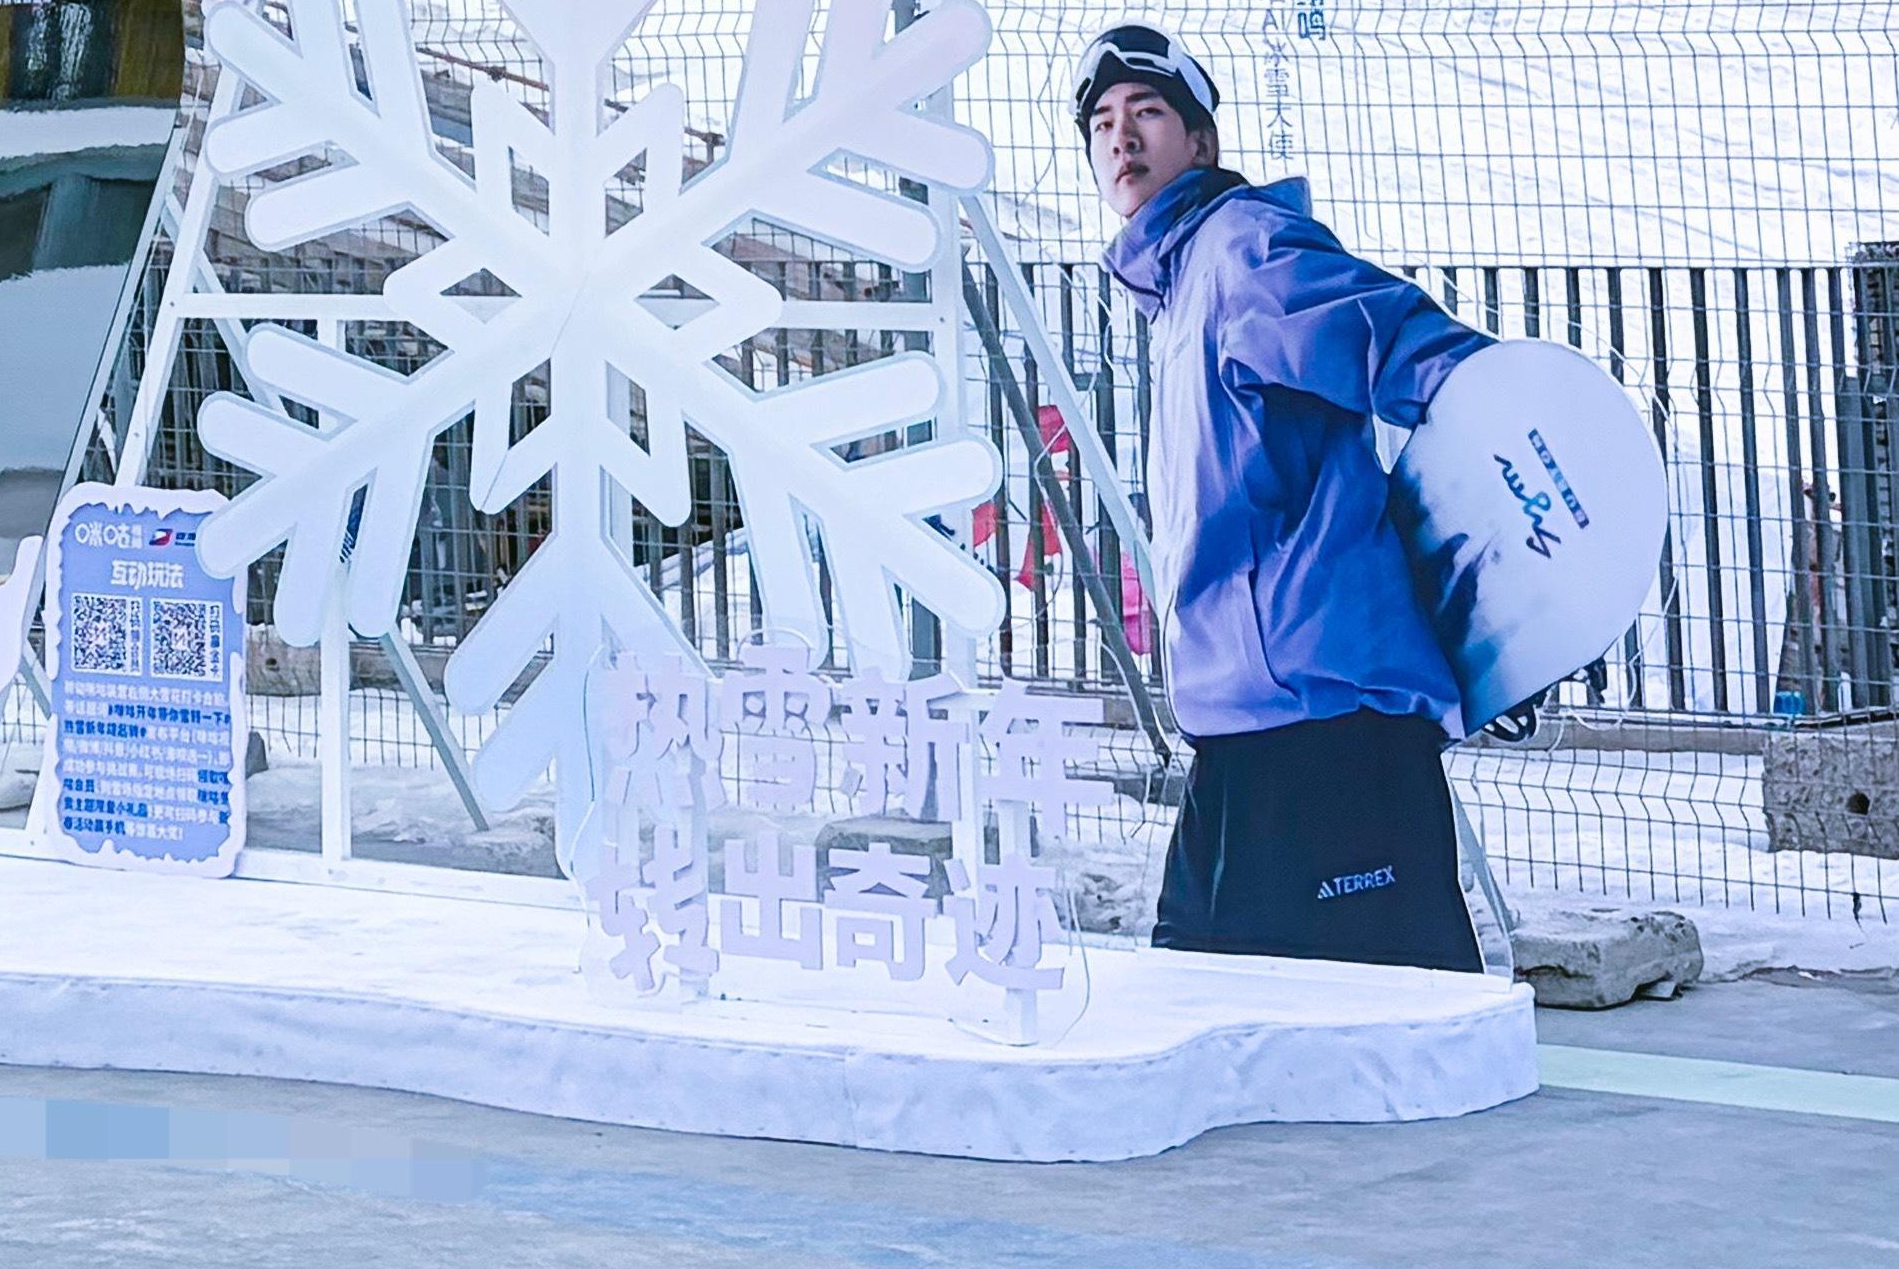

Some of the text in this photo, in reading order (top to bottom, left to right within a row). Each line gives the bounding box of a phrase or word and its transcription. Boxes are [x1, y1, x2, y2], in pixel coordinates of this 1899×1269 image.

[110, 559, 184, 590] 互动玩法
[601, 646, 1114, 837] 热雪新年
[587, 825, 1064, 991] 转出奇迹
[1333, 865, 1395, 895] TERREX
